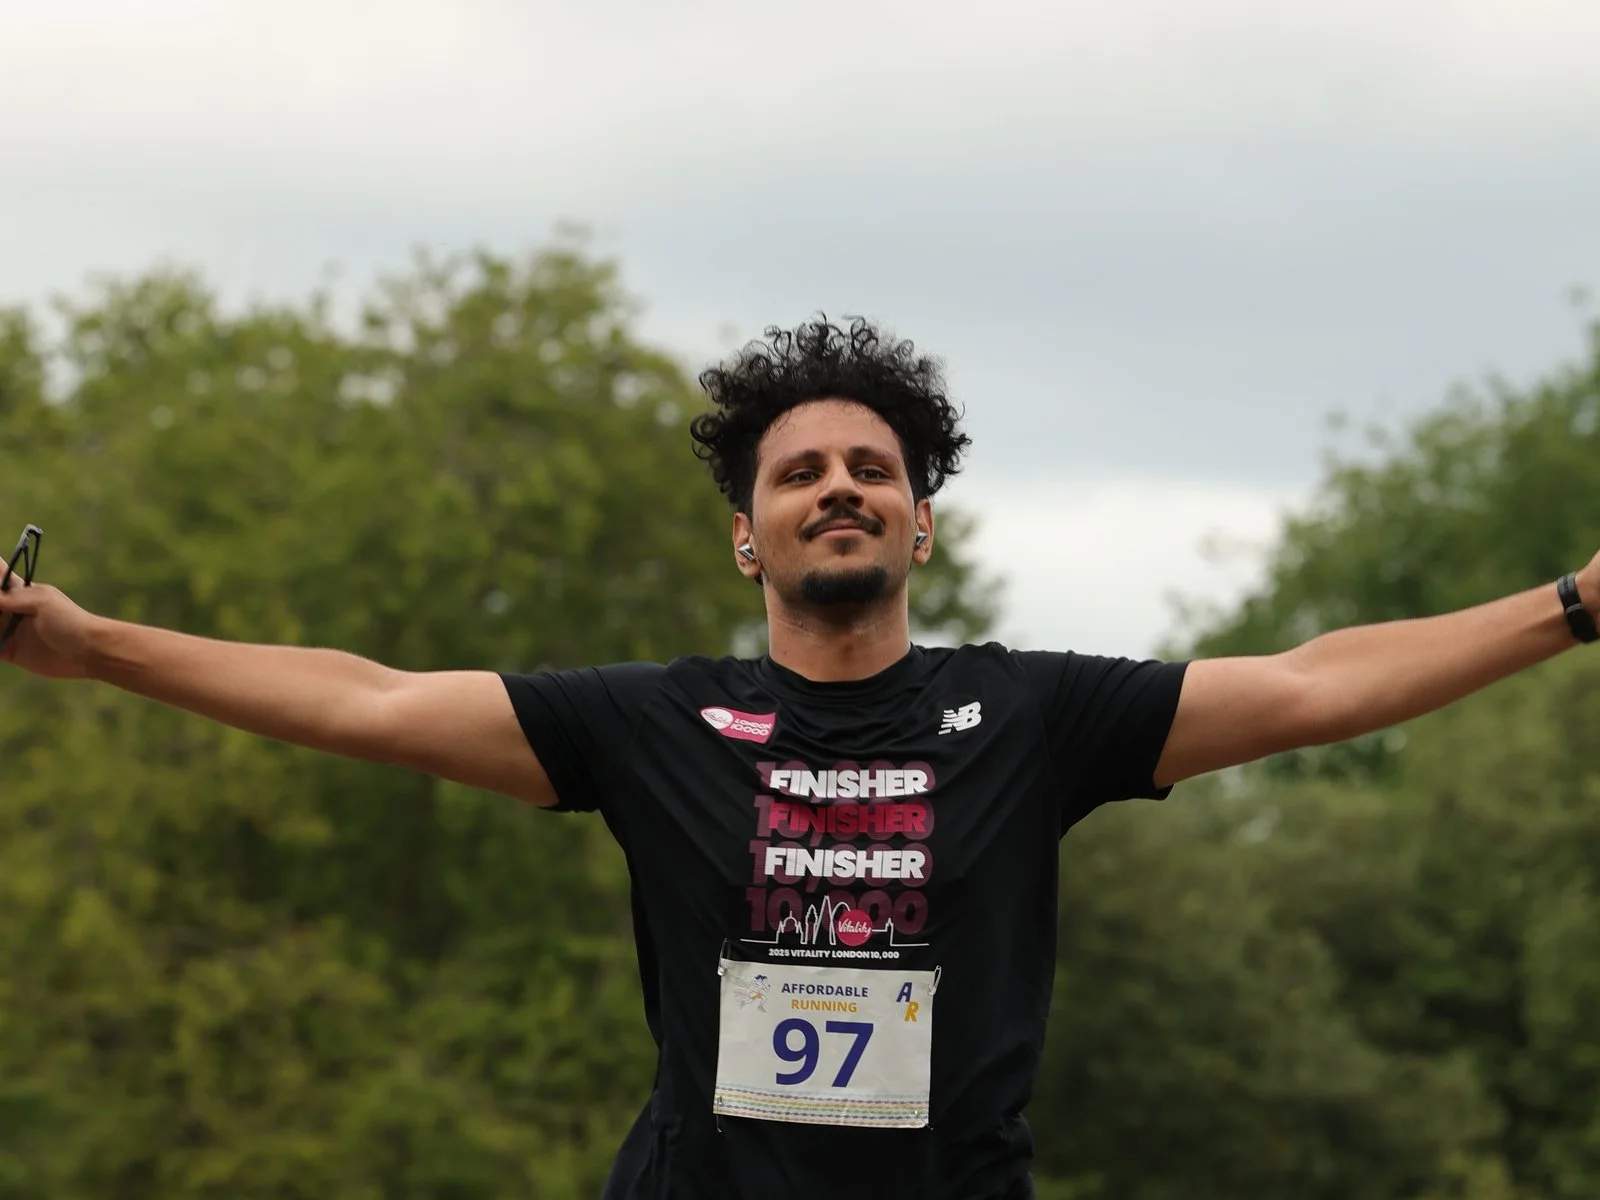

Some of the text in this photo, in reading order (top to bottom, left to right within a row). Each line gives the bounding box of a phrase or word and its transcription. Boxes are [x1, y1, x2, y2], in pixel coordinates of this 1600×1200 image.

[734, 718, 772, 729] LONDON
[769, 769, 928, 798] FINISHER
[768, 802, 927, 833] FINISHER
[764, 847, 926, 879] FINISHER
[838, 919, 872, 937] Vitality
[768, 948, 900, 960] 2025 VITALITY LONDON 10,000
[781, 983, 868, 997] AFFORDABLE
[791, 999, 857, 1013] RUNNING
[772, 1018, 874, 1088] 97
